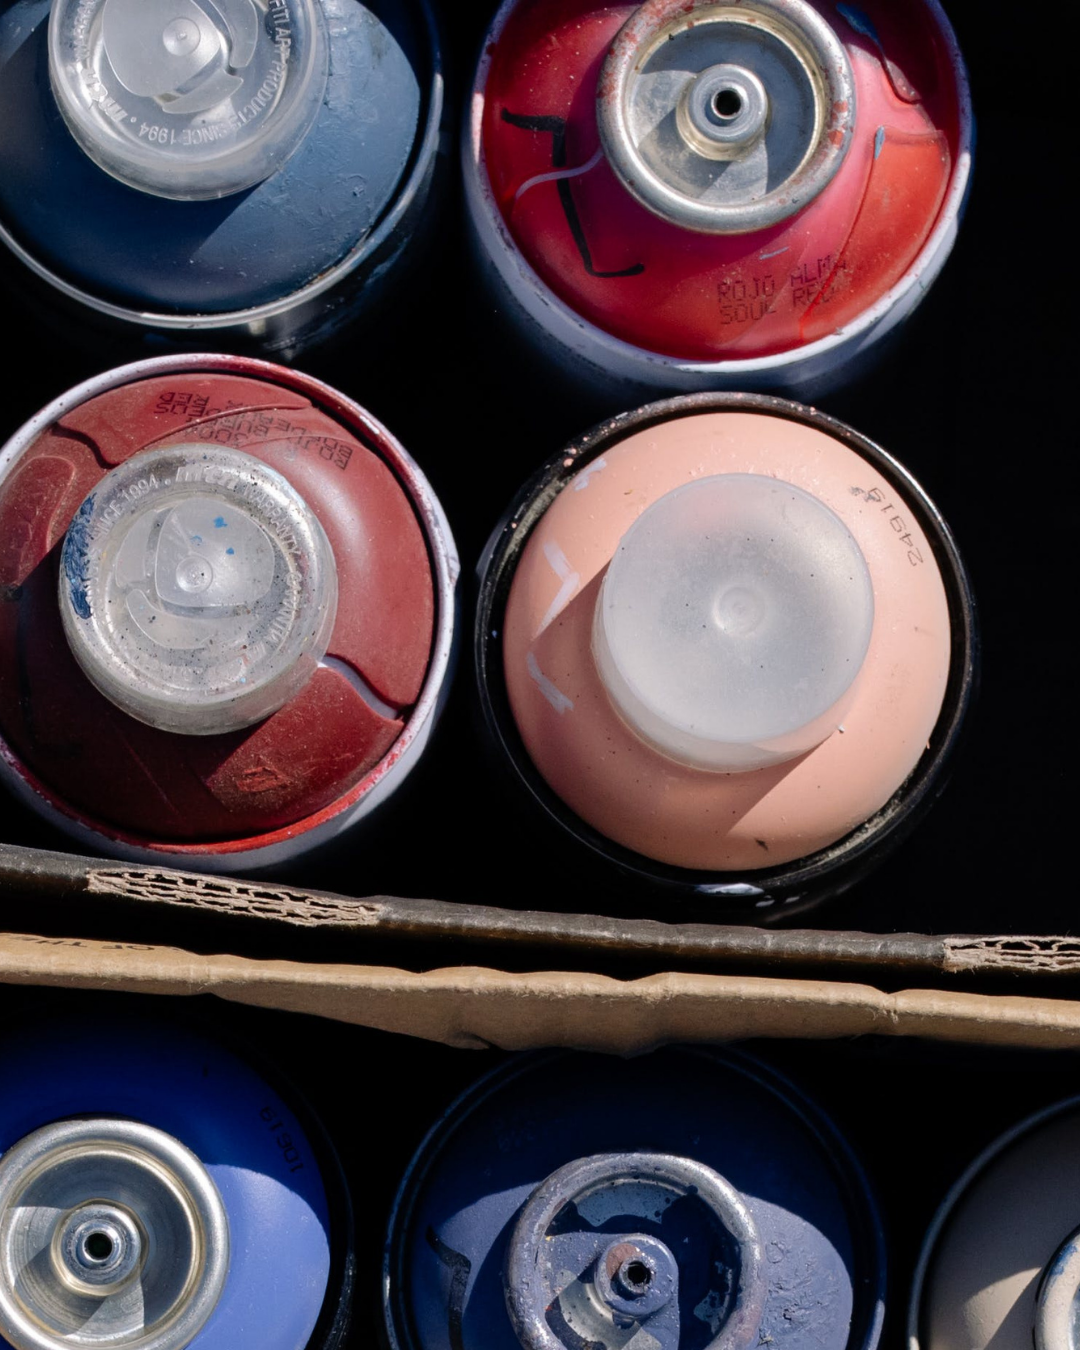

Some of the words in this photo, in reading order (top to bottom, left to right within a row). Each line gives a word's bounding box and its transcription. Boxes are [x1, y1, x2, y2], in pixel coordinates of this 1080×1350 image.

[230, 63, 287, 133] PRODUCTS
[139, 121, 177, 145] 1994
[717, 275, 775, 303] ROJO
[720, 301, 777, 324] SOUL
[121, 473, 160, 504] 1994
[868, 487, 924, 567] 24919
